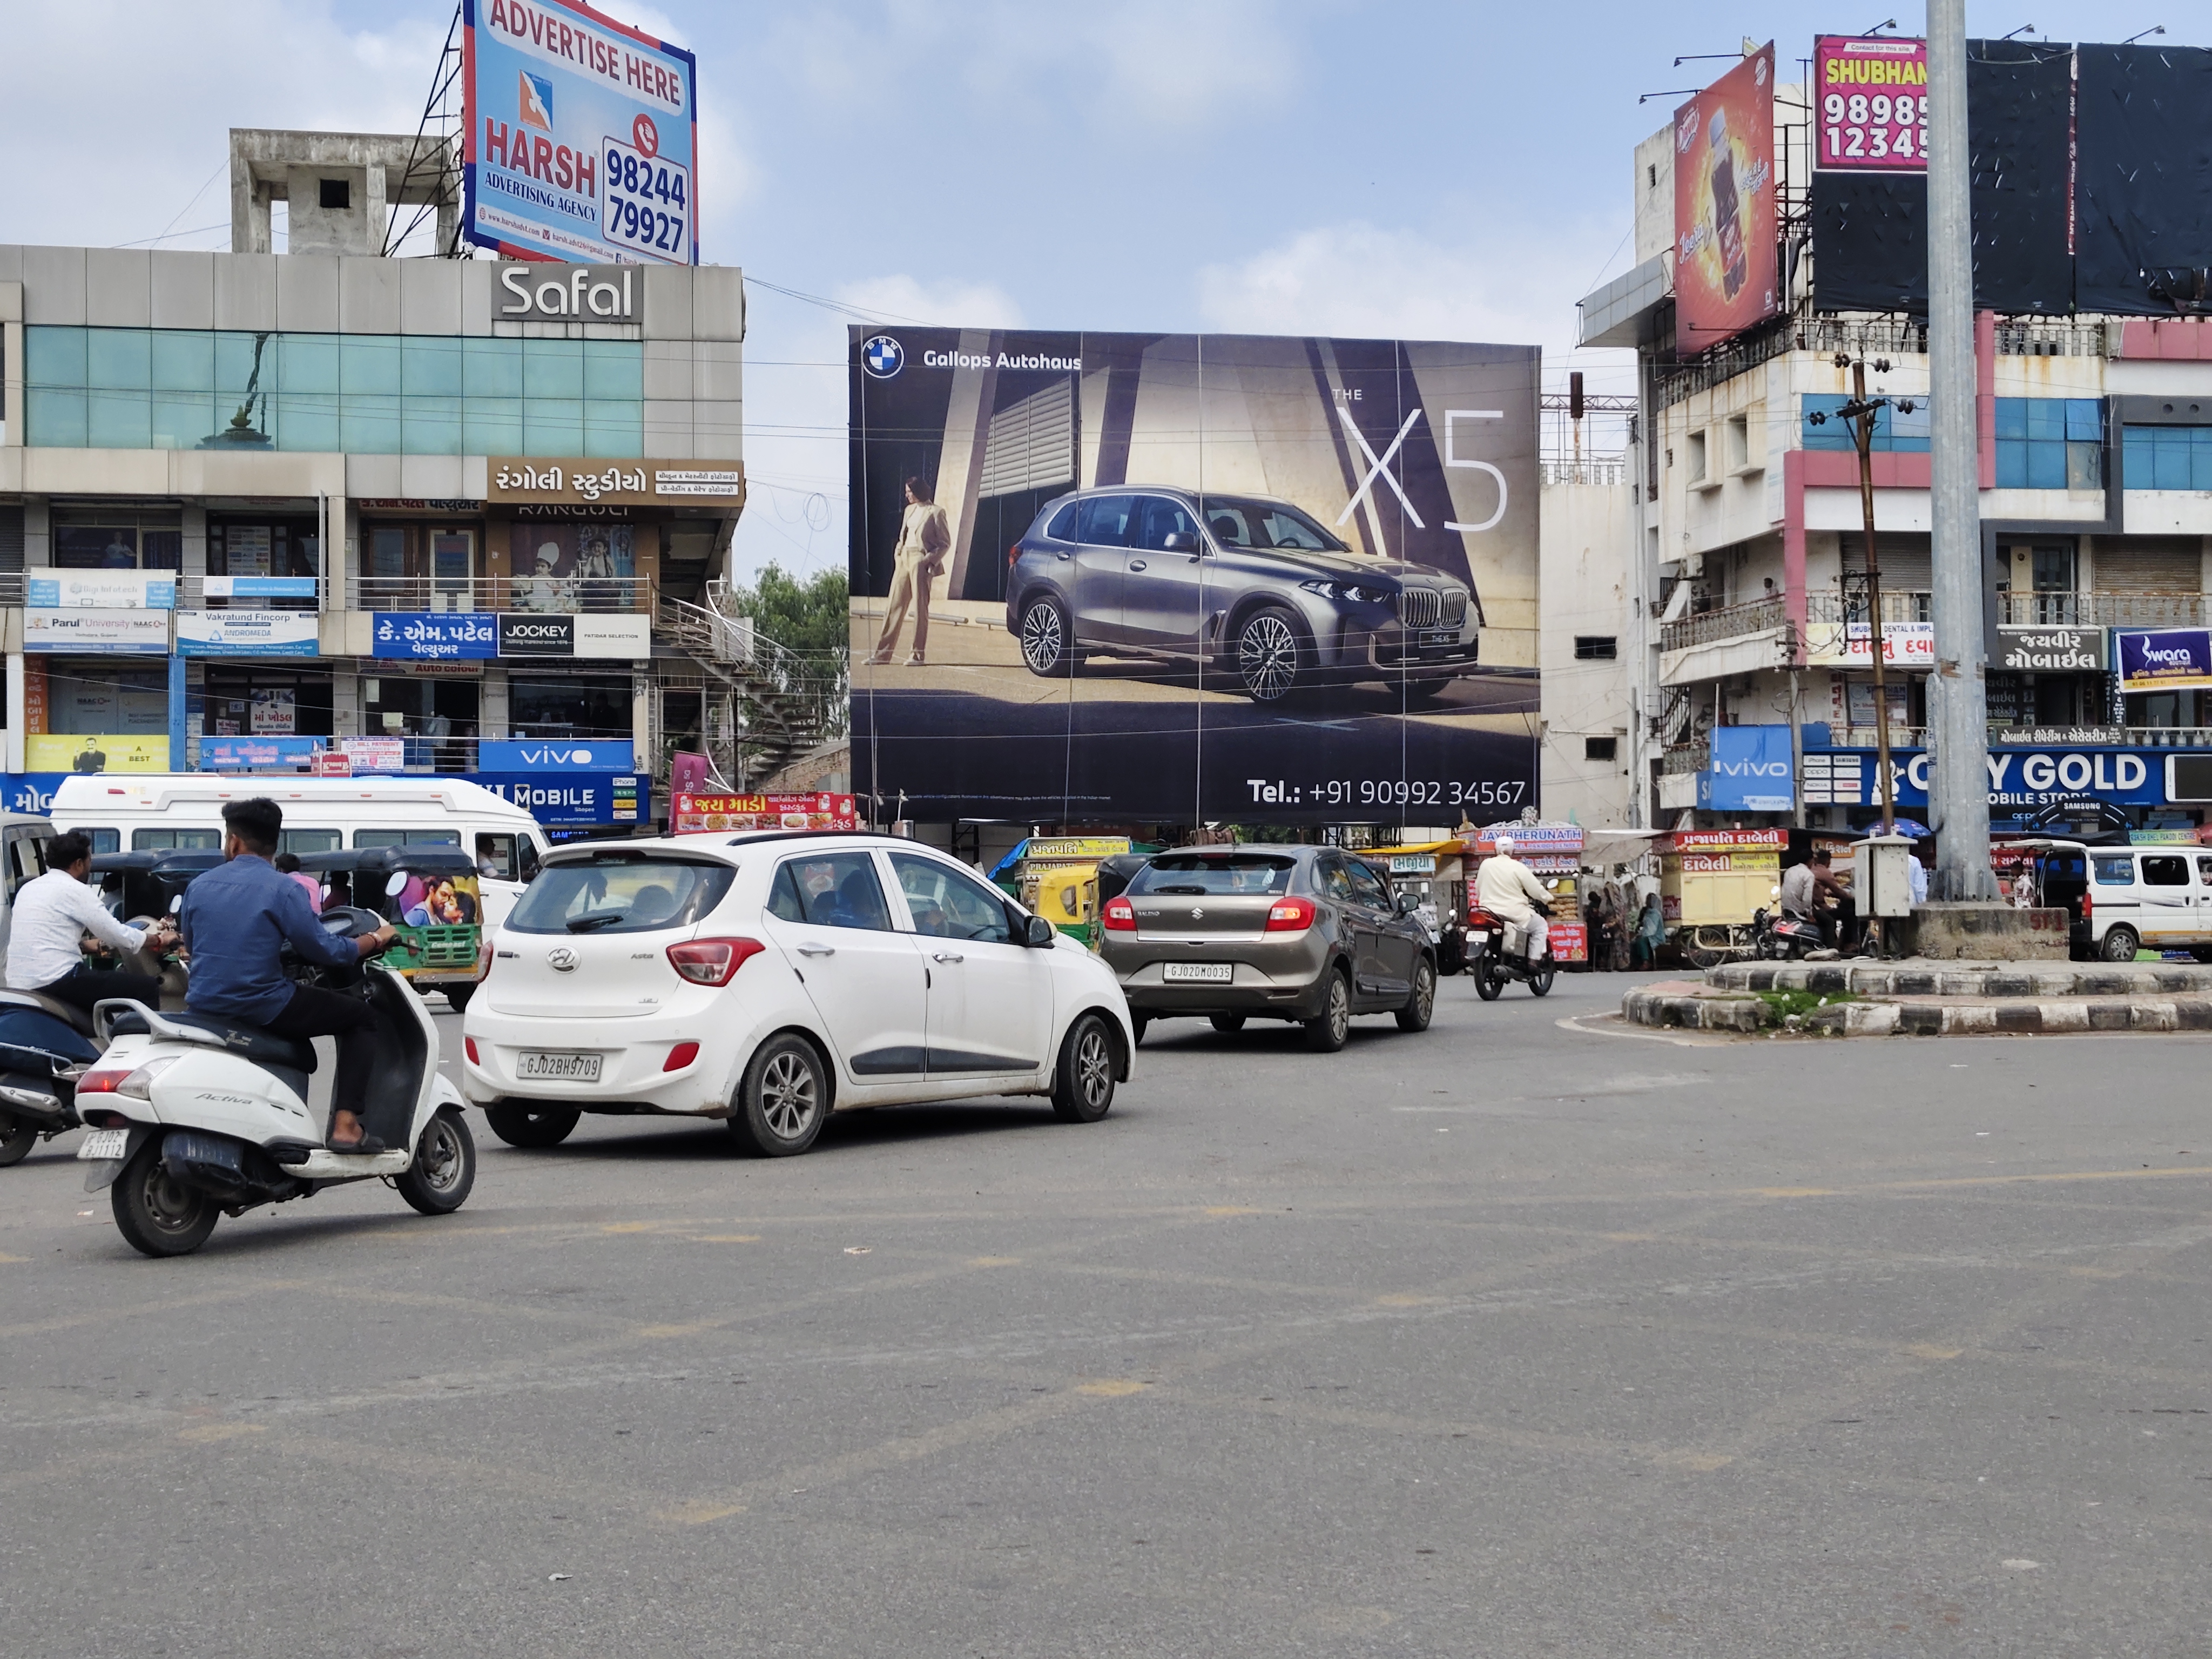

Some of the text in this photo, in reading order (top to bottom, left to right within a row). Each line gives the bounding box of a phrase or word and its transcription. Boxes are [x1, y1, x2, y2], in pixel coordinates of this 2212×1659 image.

[490, 0, 680, 106] ADVERTISE HERE
[486, 117, 595, 198] HARSH
[606, 149, 685, 211] 98244
[485, 171, 597, 221] ADVERTISING AGENCY
[610, 194, 683, 253] 79927
[501, 267, 632, 316] Safal
[867, 338, 898, 350] BMW
[923, 350, 1081, 370] Gallops Autohaus
[1332, 389, 1363, 400] THE
[1335, 407, 1507, 531] X5
[496, 464, 646, 500] રંગોલી સ્ટુડીયો
[52, 618, 79, 627] Parul
[85, 619, 130, 629] University
[206, 613, 252, 621] Vakratund
[255, 613, 290, 622] Fincorp
[505, 625, 568, 637] JOCKEY
[2020, 631, 2081, 648] જયવીર
[412, 640, 458, 658] વેલ્યુઅર
[2005, 648, 2096, 667] મોબાઈલ
[415, 664, 479, 672] Auto colour
[521, 745, 592, 764] vivo
[1723, 758, 1788, 776] vivo
[2023, 754, 2146, 790] GOLD
[515, 787, 595, 806] MOBILE
[1246, 779, 1525, 805] Tel.: +91 90992 34567
[1987, 792, 2034, 805] OBILE
[695, 799, 724, 812] જય
[1479, 830, 1503, 841] JAY
[1684, 830, 1778, 844] પ્રજાપતિ દાબેલી
[1684, 855, 1729, 871] દાબેલી
[1171, 964, 1230, 977] GJ02DM0035
[527, 1054, 598, 1076] GJ02BH9709
[195, 1092, 253, 1104] Activa
[98, 1131, 119, 1143] GJ02
[86, 1144, 122, 1156] BJ1112
